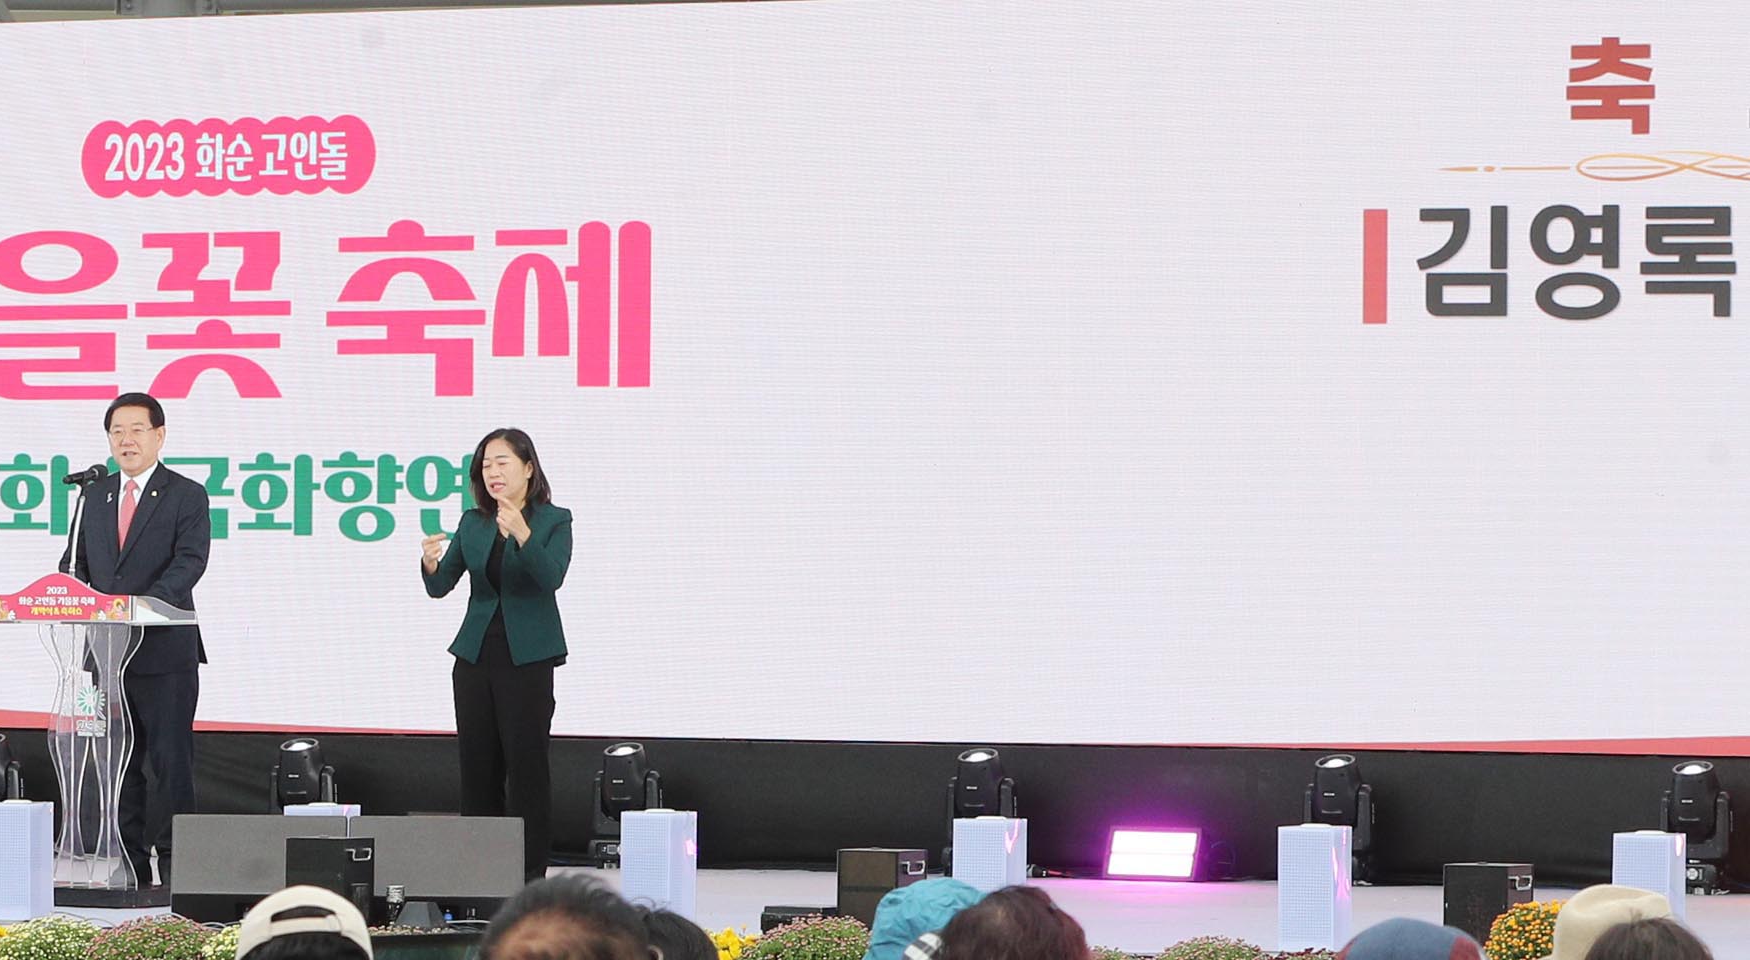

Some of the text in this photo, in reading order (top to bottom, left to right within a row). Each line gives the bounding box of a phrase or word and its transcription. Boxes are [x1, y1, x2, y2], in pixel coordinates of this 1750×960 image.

[1566, 36, 1656, 135] 축
[104, 131, 348, 182] 2023 화순 고인돌
[326, 219, 652, 397] 축제
[1416, 204, 1737, 321] 김영록
[46, 586, 68, 595] 2023
